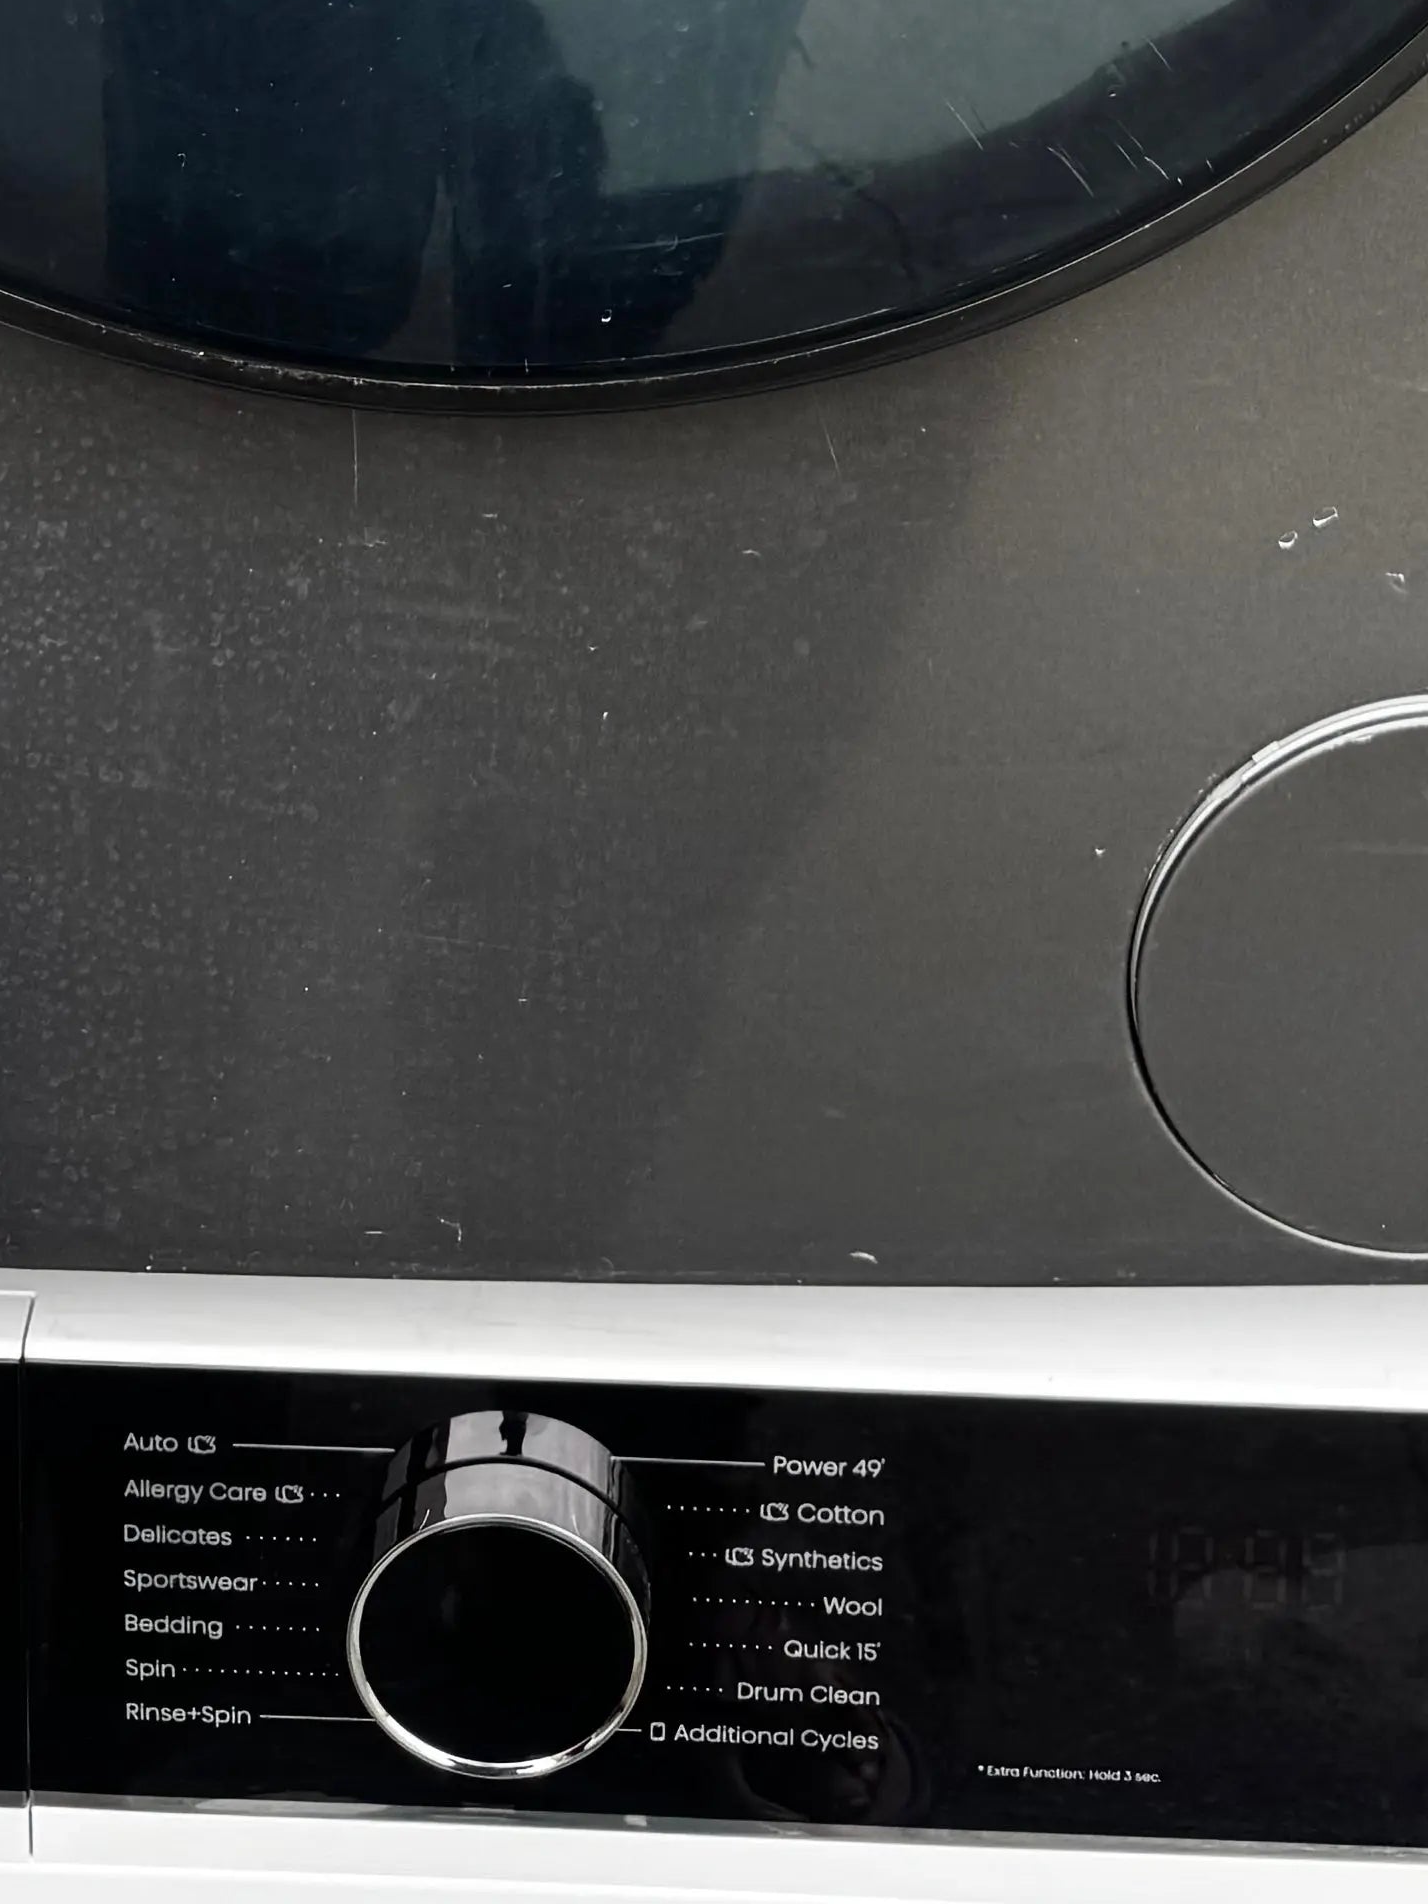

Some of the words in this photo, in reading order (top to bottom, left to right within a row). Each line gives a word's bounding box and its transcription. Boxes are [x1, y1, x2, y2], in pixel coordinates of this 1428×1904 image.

[123, 1432, 179, 1453] Auto
[773, 1455, 848, 1477] Power
[852, 1457, 886, 1478] 49'
[123, 1479, 204, 1505] Allergy
[209, 1482, 267, 1503] Care
[797, 1502, 885, 1526] Cotton
[123, 1523, 233, 1546] Delicates
[761, 1548, 884, 1572] Synthetics
[123, 1569, 259, 1593] Sportswear
[823, 1596, 883, 1617] Wool
[124, 1613, 223, 1640] Bedding
[783, 1639, 851, 1660] Quick
[125, 1658, 176, 1681] Spin
[737, 1681, 804, 1702] Drum
[810, 1685, 880, 1706] Clean
[125, 1702, 252, 1728] Rinse+Spin
[673, 1723, 794, 1746] Additional
[800, 1729, 879, 1753] Cycles
[987, 1764, 1020, 1778] Extra
[1089, 1768, 1121, 1782] Hold
[1124, 1770, 1132, 1782] 3
